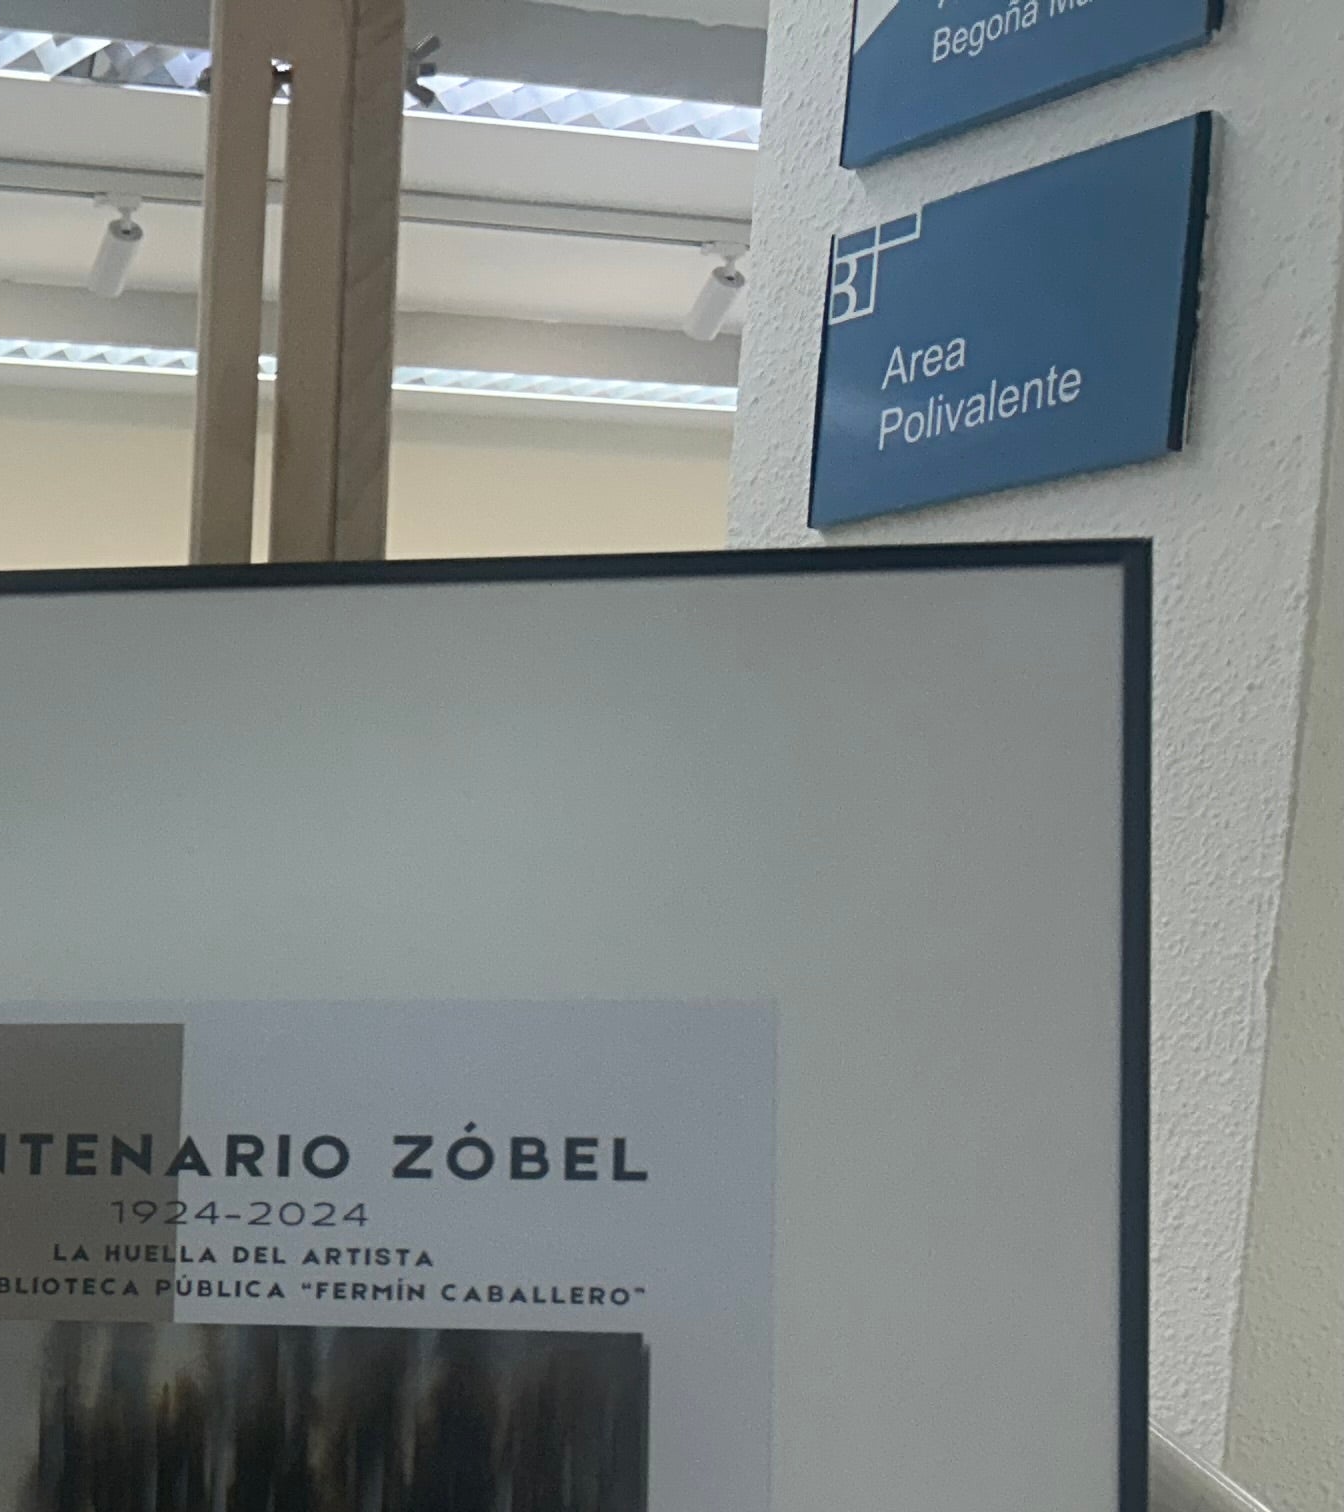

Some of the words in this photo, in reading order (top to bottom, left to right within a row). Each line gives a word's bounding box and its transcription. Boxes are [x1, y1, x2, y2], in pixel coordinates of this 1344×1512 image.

[881, 336, 966, 390] Area
[878, 366, 1082, 451] Polivalente
[392, 1121, 648, 1181] ZÓBEL
[112, 1200, 369, 1227] 1924-2024
[53, 1243, 91, 1263] LA
[105, 1244, 216, 1264] HUELLA
[232, 1246, 286, 1265] DEL
[302, 1247, 434, 1267] ARTISTA
[155, 1274, 286, 1299] PÚBLICA
